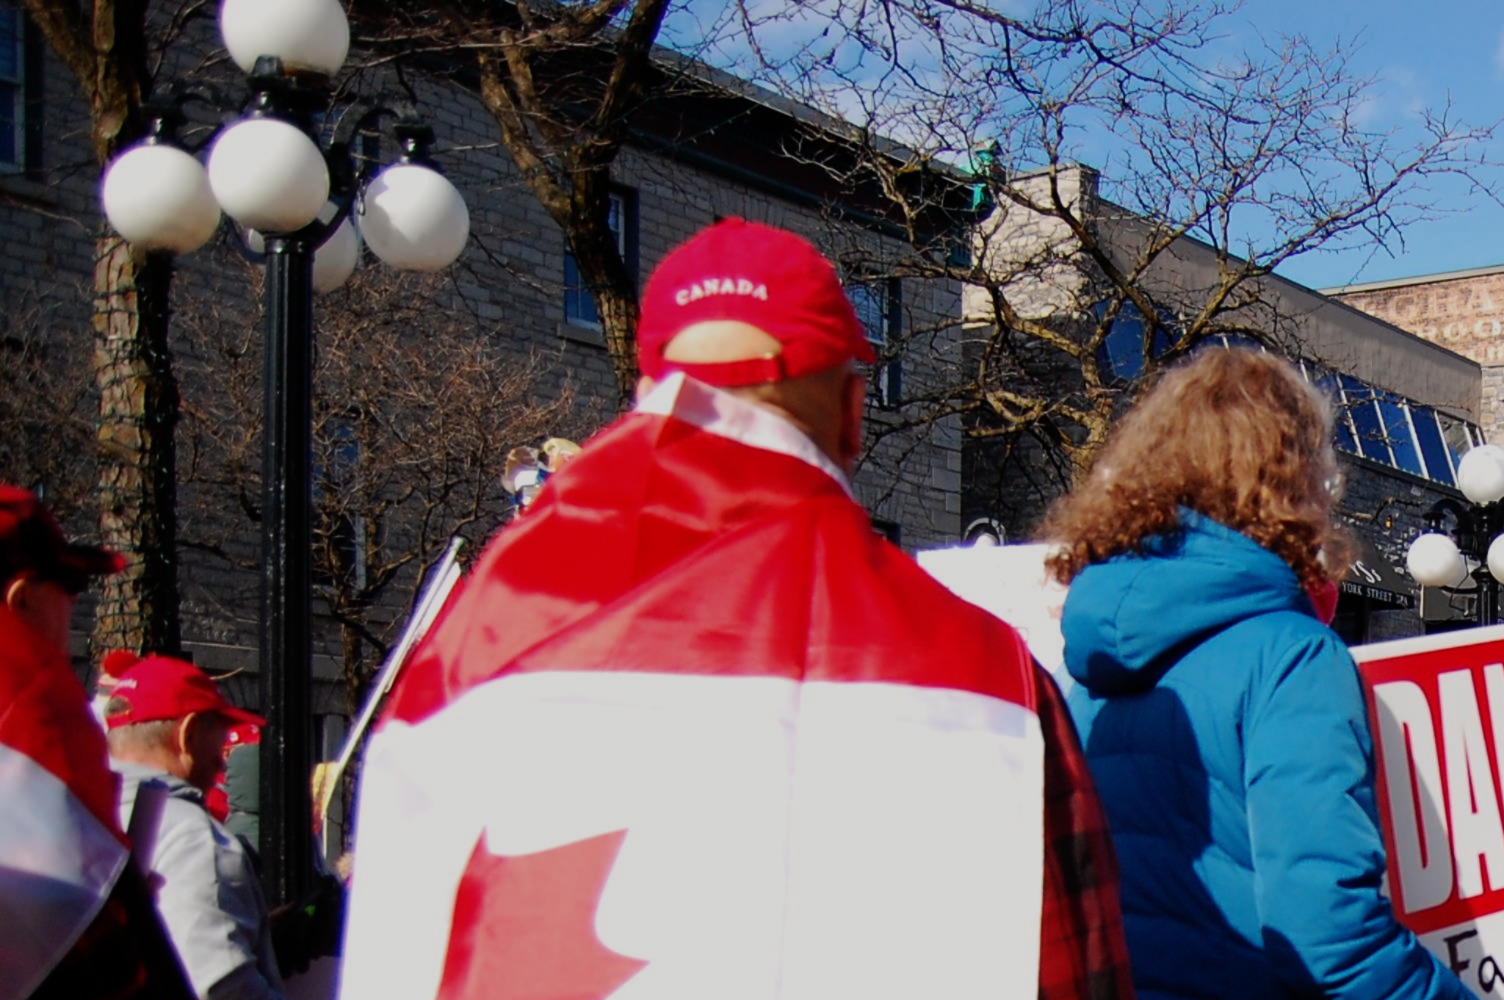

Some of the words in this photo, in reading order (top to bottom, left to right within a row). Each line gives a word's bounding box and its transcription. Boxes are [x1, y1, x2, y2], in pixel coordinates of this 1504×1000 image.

[676, 278, 769, 306] CANADA
[1342, 581, 1362, 596] YORK
[1367, 588, 1393, 603] STREET
